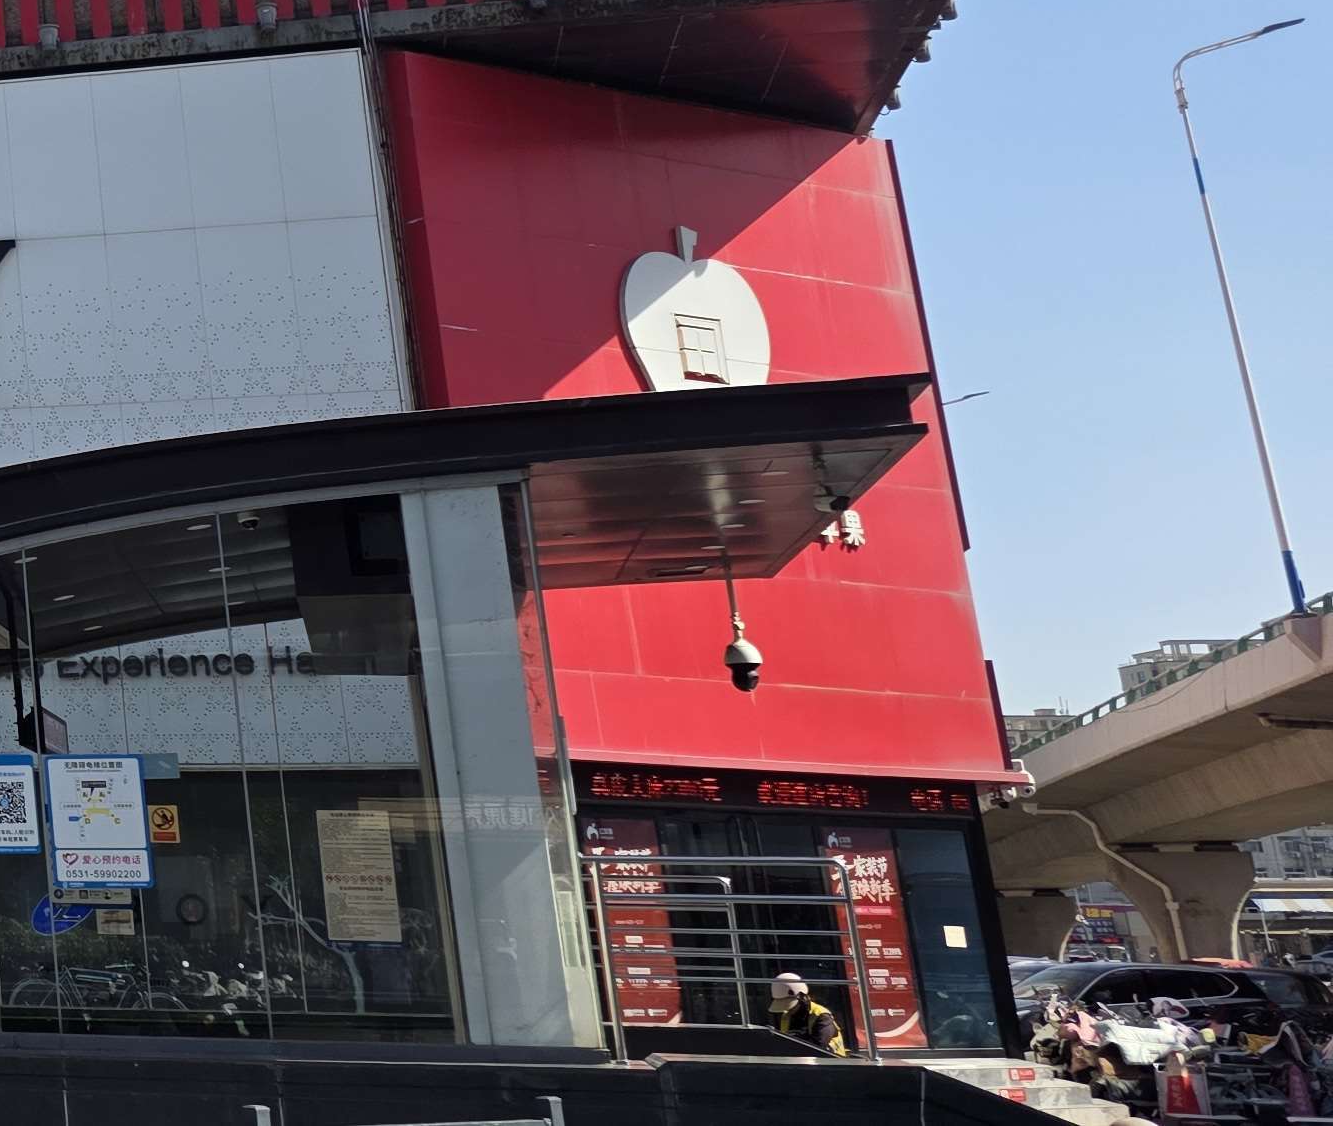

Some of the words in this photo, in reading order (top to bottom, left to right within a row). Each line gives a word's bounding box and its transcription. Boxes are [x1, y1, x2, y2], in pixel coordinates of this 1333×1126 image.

[82, 854, 142, 866] 爱心预约电话
[65, 869, 142, 879] 0531-59902200
